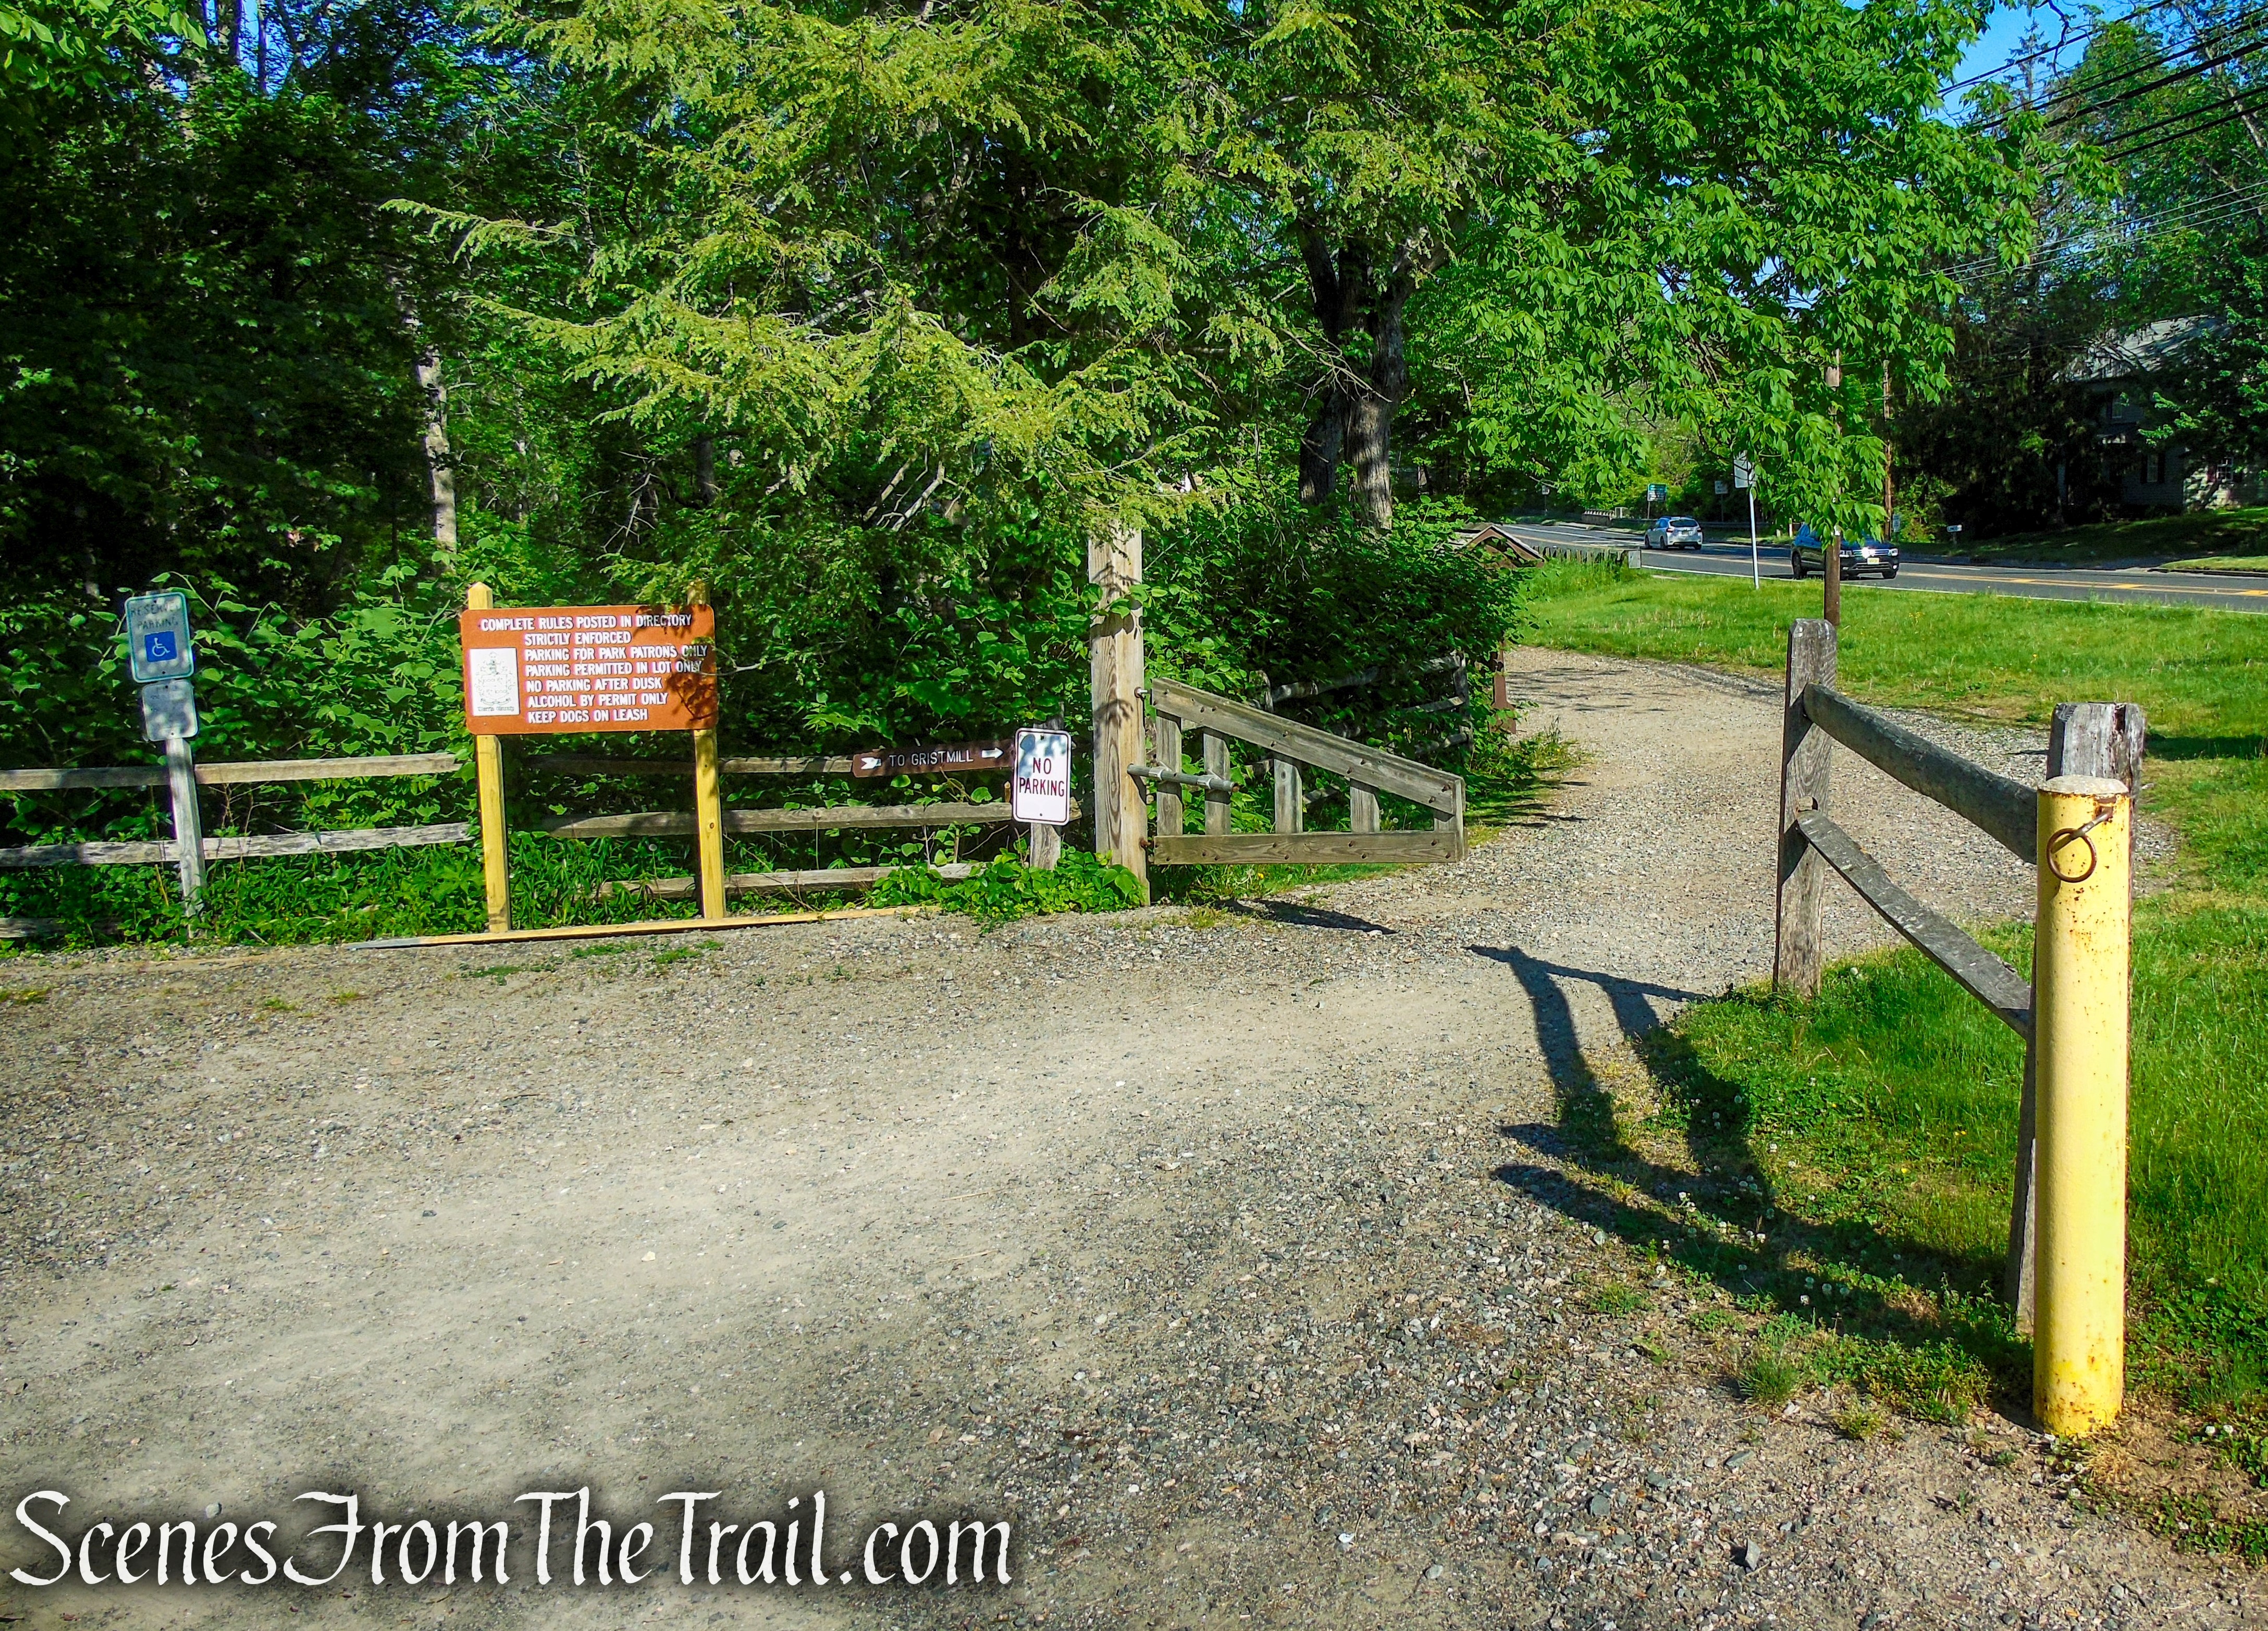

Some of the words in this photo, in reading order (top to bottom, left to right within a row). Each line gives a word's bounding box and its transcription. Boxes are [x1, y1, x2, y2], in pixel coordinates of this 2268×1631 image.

[137, 617, 178, 630] PARKING
[480, 618, 535, 631] COMPLETE
[538, 617, 573, 630] RULES
[577, 615, 617, 629] POSTED
[621, 615, 632, 627] IN
[636, 614, 692, 627] DIRECTORY
[524, 633, 570, 645] STRICTLY
[575, 631, 631, 644] ENFORCED
[524, 648, 570, 661] PARKING
[574, 647, 595, 659] FOR
[599, 647, 626, 659] PARK
[631, 645, 677, 658] PATRONS
[525, 664, 571, 677] PARKING
[575, 662, 633, 675] PERMITTED
[637, 662, 647, 673] IN
[652, 661, 672, 673] LOT
[677, 661, 702, 672] ONLY
[526, 680, 542, 692] NO
[546, 679, 591, 692] PARKING
[595, 678, 628, 691] AFTER
[633, 677, 662, 690] DUSK
[527, 695, 576, 708] ALCOHOL
[581, 694, 595, 706] BY
[599, 693, 637, 706] PERMIT
[642, 692, 668, 705] ONLY
[528, 710, 557, 723] KEEP
[561, 710, 589, 722] DOGS
[594, 709, 609, 721] ON
[613, 708, 648, 721] LEASH
[890, 754, 905, 767] TO
[1033, 757, 1052, 774] NO
[1019, 777, 1065, 797] PARKING
